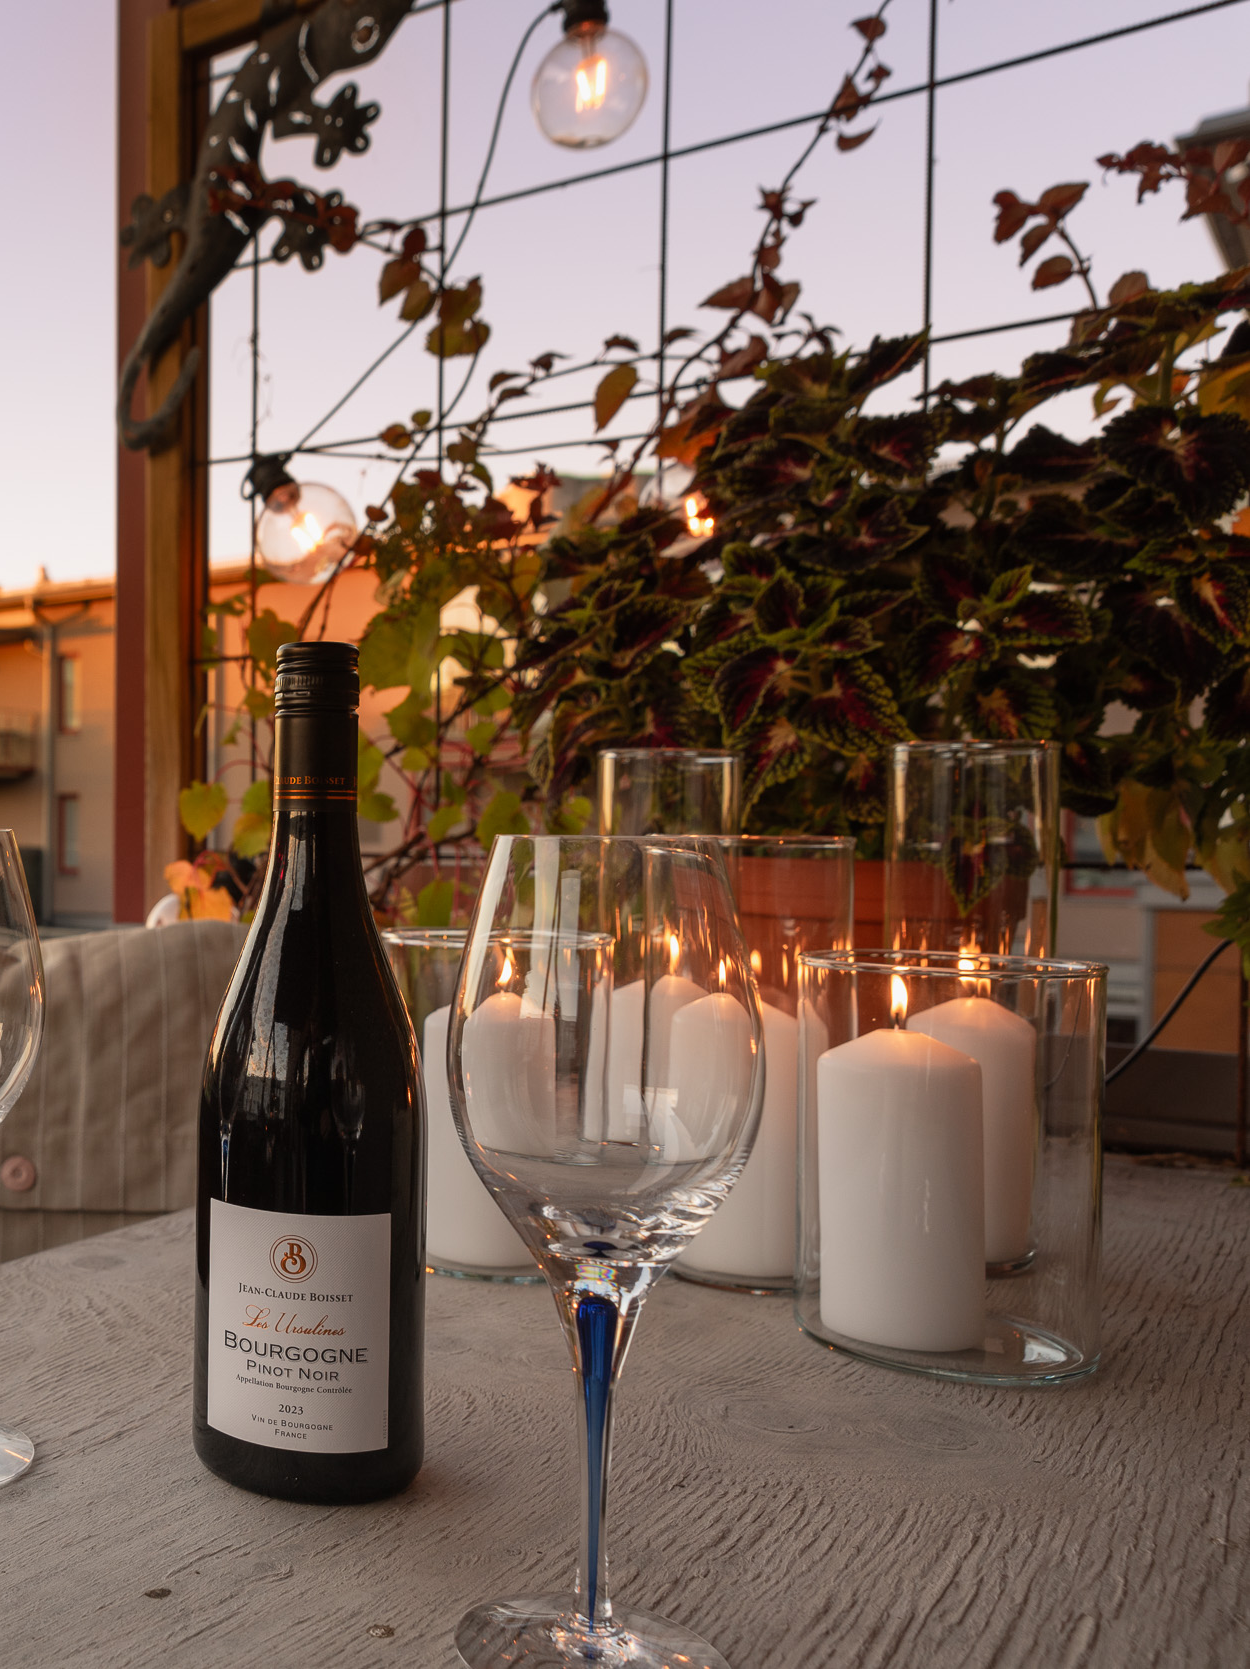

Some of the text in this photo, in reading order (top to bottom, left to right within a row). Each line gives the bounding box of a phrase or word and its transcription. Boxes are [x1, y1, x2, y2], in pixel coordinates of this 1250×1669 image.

[238, 1282, 354, 1302] JEAN-CLAUDE BOISSET
[242, 1304, 347, 1336] Les Ursulines
[224, 1329, 369, 1364] BOURGOGNE
[246, 1359, 340, 1381] PINOT NOIR
[235, 1373, 353, 1394] Appellation Bourgogne Contrôlée
[278, 1403, 304, 1416] 2023
[251, 1413, 334, 1431] VIN DE BOURGOGNE
[274, 1428, 308, 1440] FRANCE
